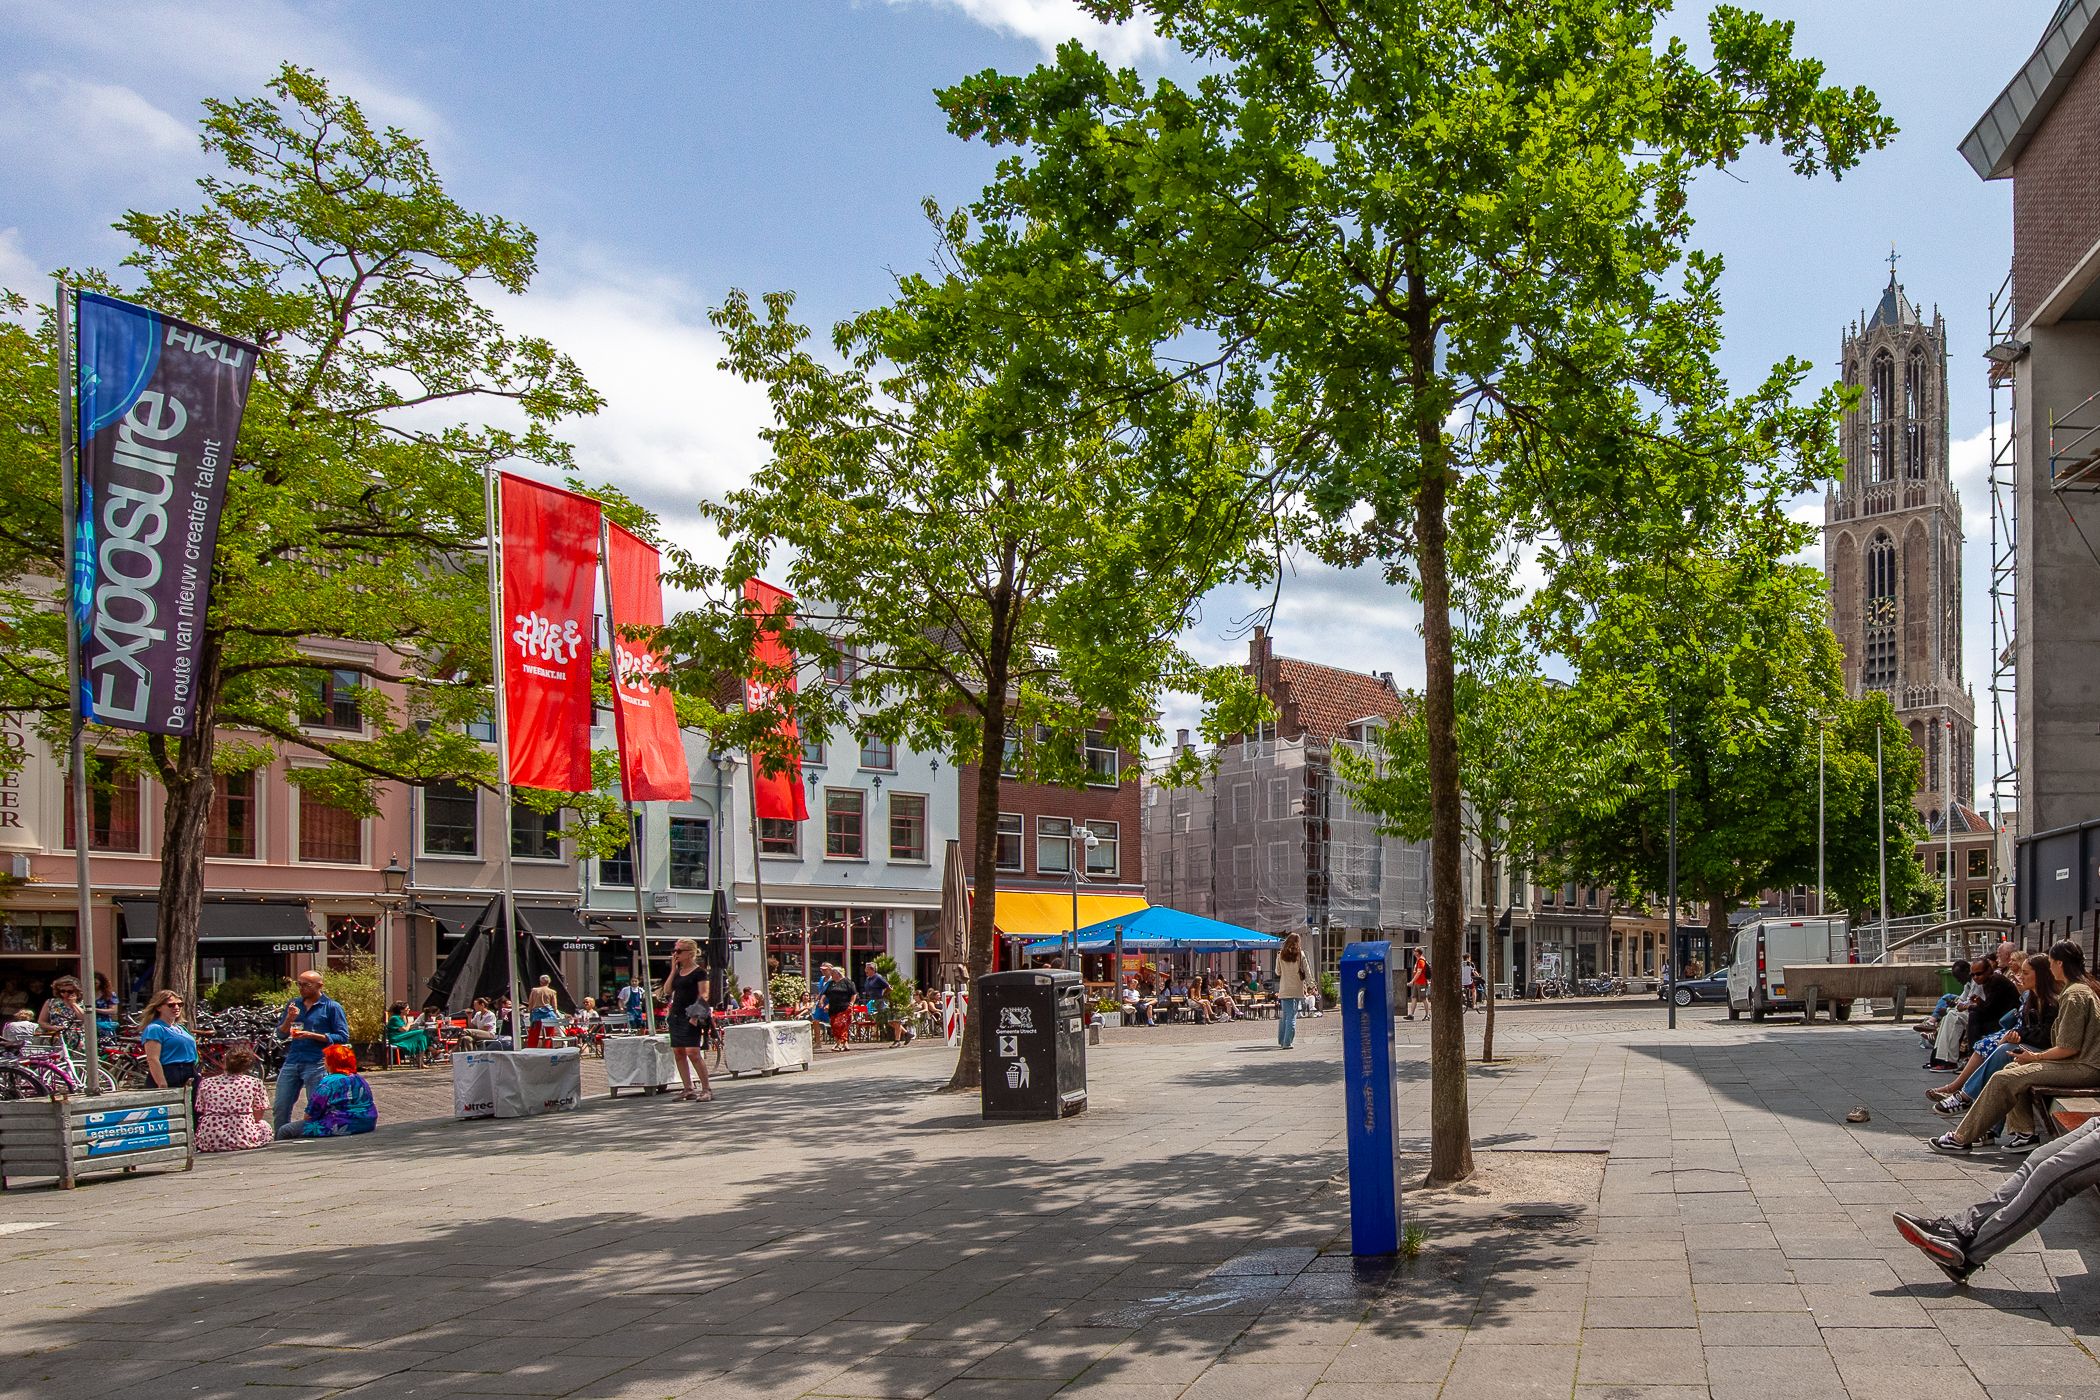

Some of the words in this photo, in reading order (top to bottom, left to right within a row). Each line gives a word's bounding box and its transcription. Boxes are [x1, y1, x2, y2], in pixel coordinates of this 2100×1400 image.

[166, 326, 244, 368] HKU
[195, 438, 221, 488] talent
[185, 491, 209, 560] creatief
[92, 390, 188, 723] Exposure
[175, 564, 198, 617] nieuw
[176, 621, 193, 651] van
[173, 656, 191, 701] route
[167, 705, 185, 728] De
[273, 943, 313, 951] daen's
[563, 942, 595, 950] daen's
